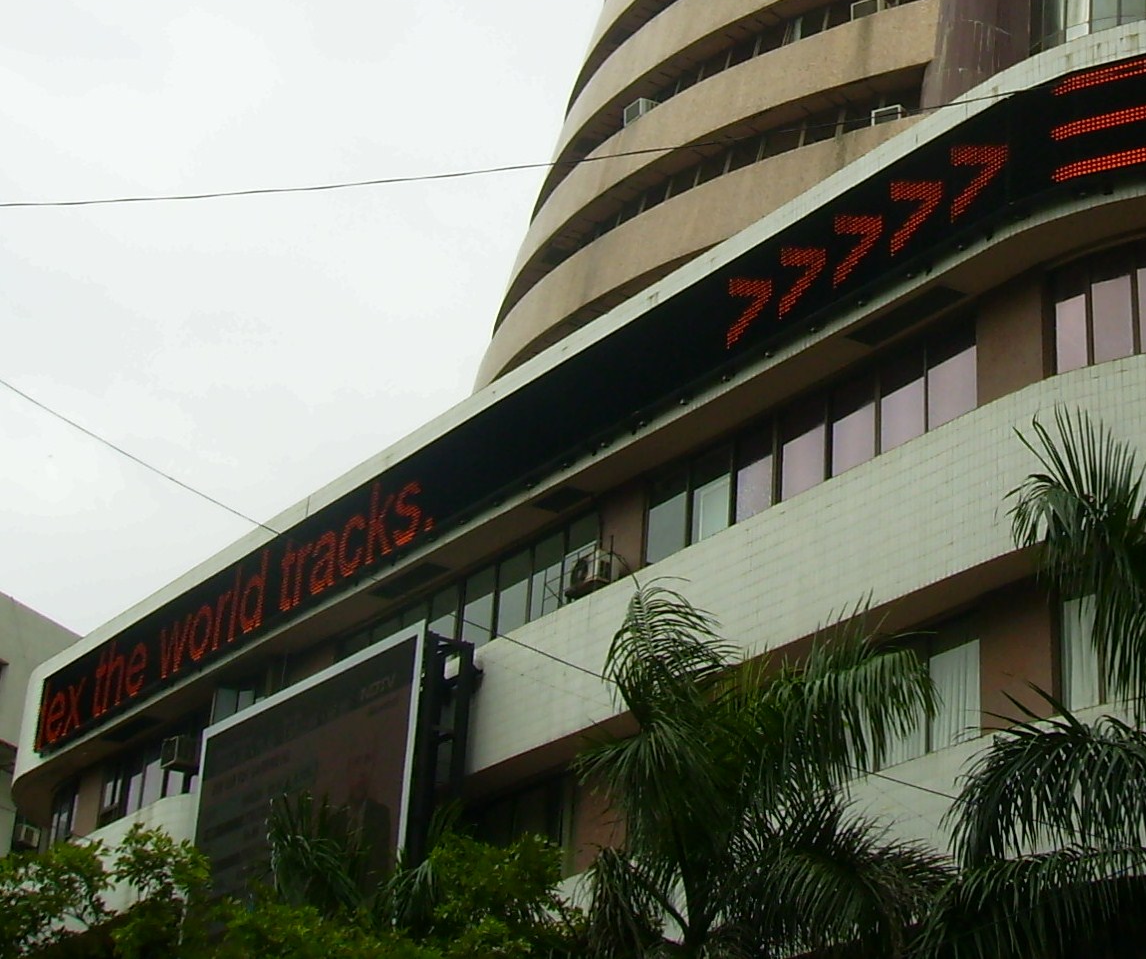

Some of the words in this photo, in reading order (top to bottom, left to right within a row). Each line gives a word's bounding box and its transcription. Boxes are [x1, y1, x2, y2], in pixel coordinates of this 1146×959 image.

[94, 640, 148, 718] the
[160, 549, 270, 679] world
[279, 482, 434, 612] tracks.
